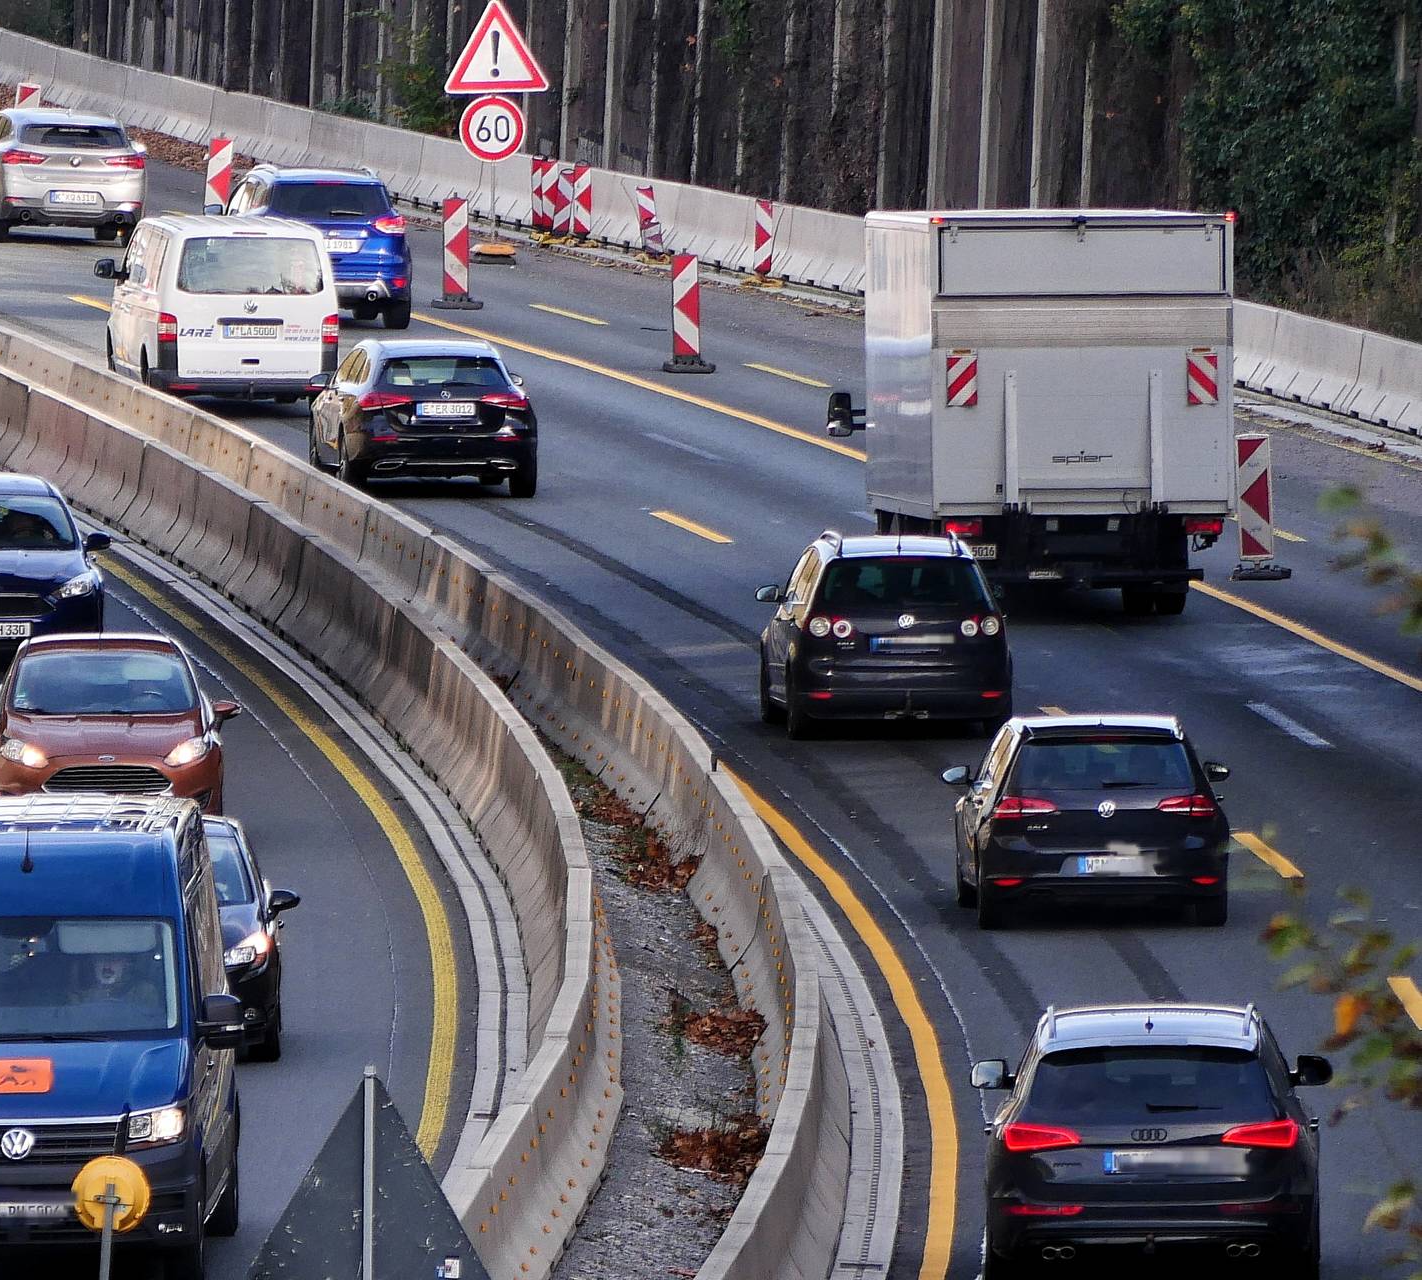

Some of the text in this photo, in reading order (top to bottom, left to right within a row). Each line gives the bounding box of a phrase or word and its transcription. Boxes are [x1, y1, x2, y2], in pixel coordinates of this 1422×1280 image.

[476, 115, 510, 143] 60
[333, 240, 353, 249] 1981
[1051, 450, 1114, 466] spier
[971, 546, 995, 557] 5016
[5, 625, 26, 636] 330
